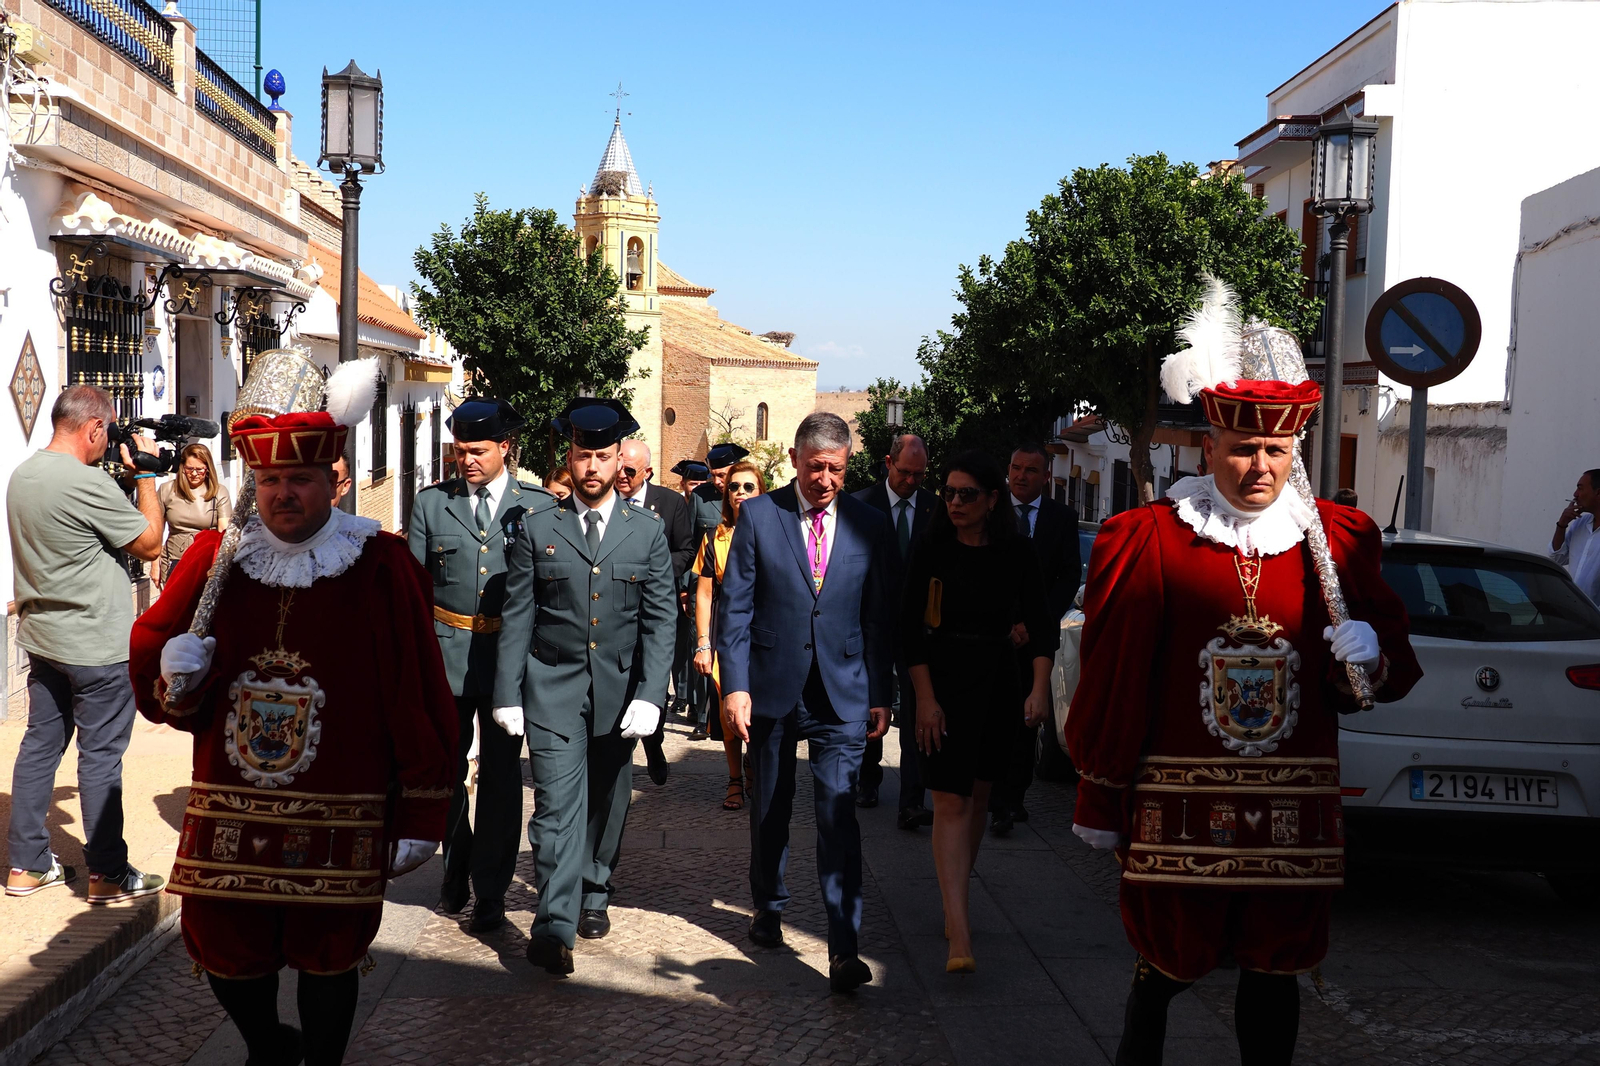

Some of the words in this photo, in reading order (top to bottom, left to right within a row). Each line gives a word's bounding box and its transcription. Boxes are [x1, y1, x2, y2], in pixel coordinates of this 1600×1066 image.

[1415, 787, 1421, 795] E
[1429, 774, 1495, 800] 2194
[1505, 777, 1550, 802] HYF
